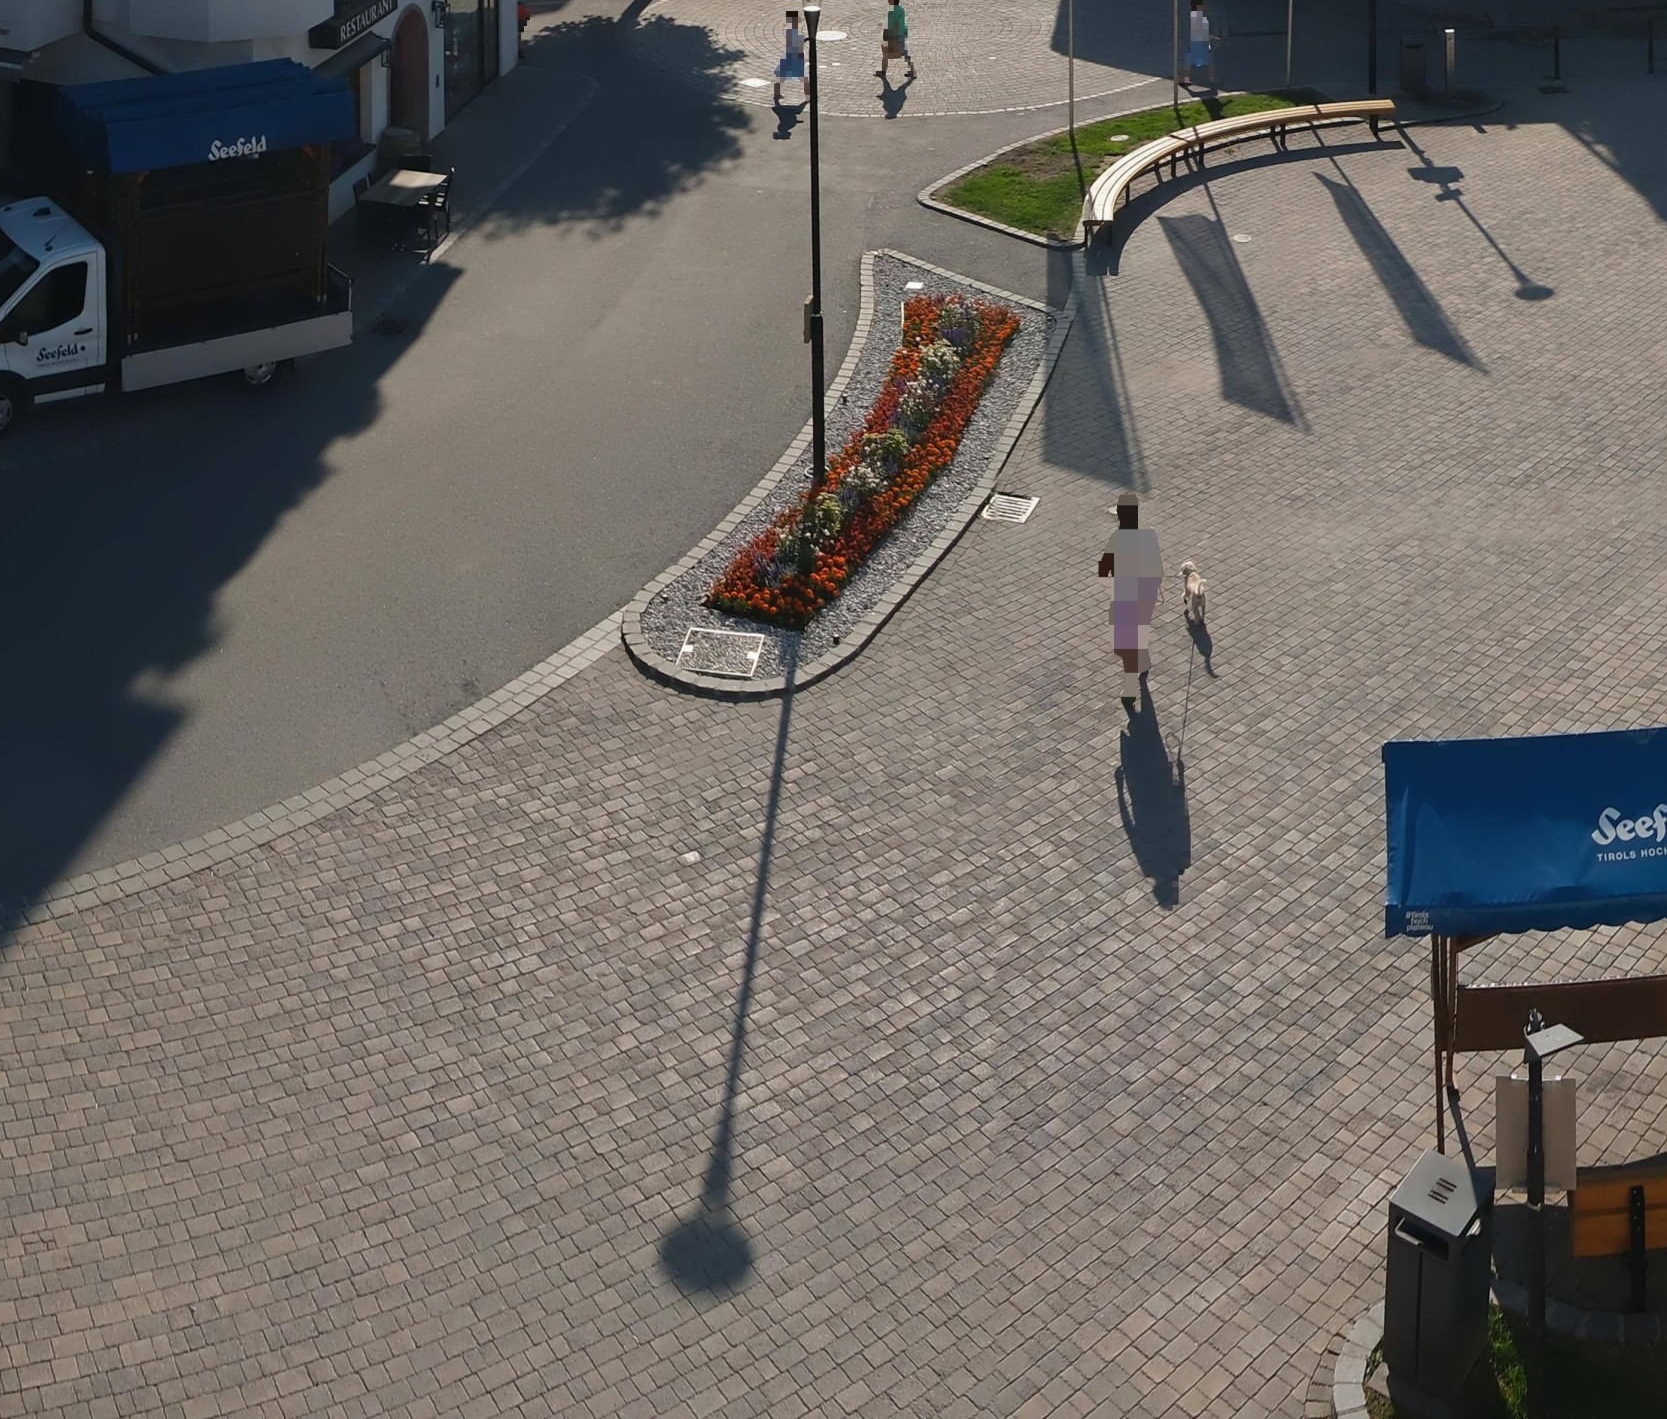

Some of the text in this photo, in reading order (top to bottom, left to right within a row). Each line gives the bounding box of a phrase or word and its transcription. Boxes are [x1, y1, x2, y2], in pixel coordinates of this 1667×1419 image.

[208, 134, 267, 161] Seefeld
[36, 343, 78, 362] Seefeld
[1597, 850, 1636, 862] TIROLS
